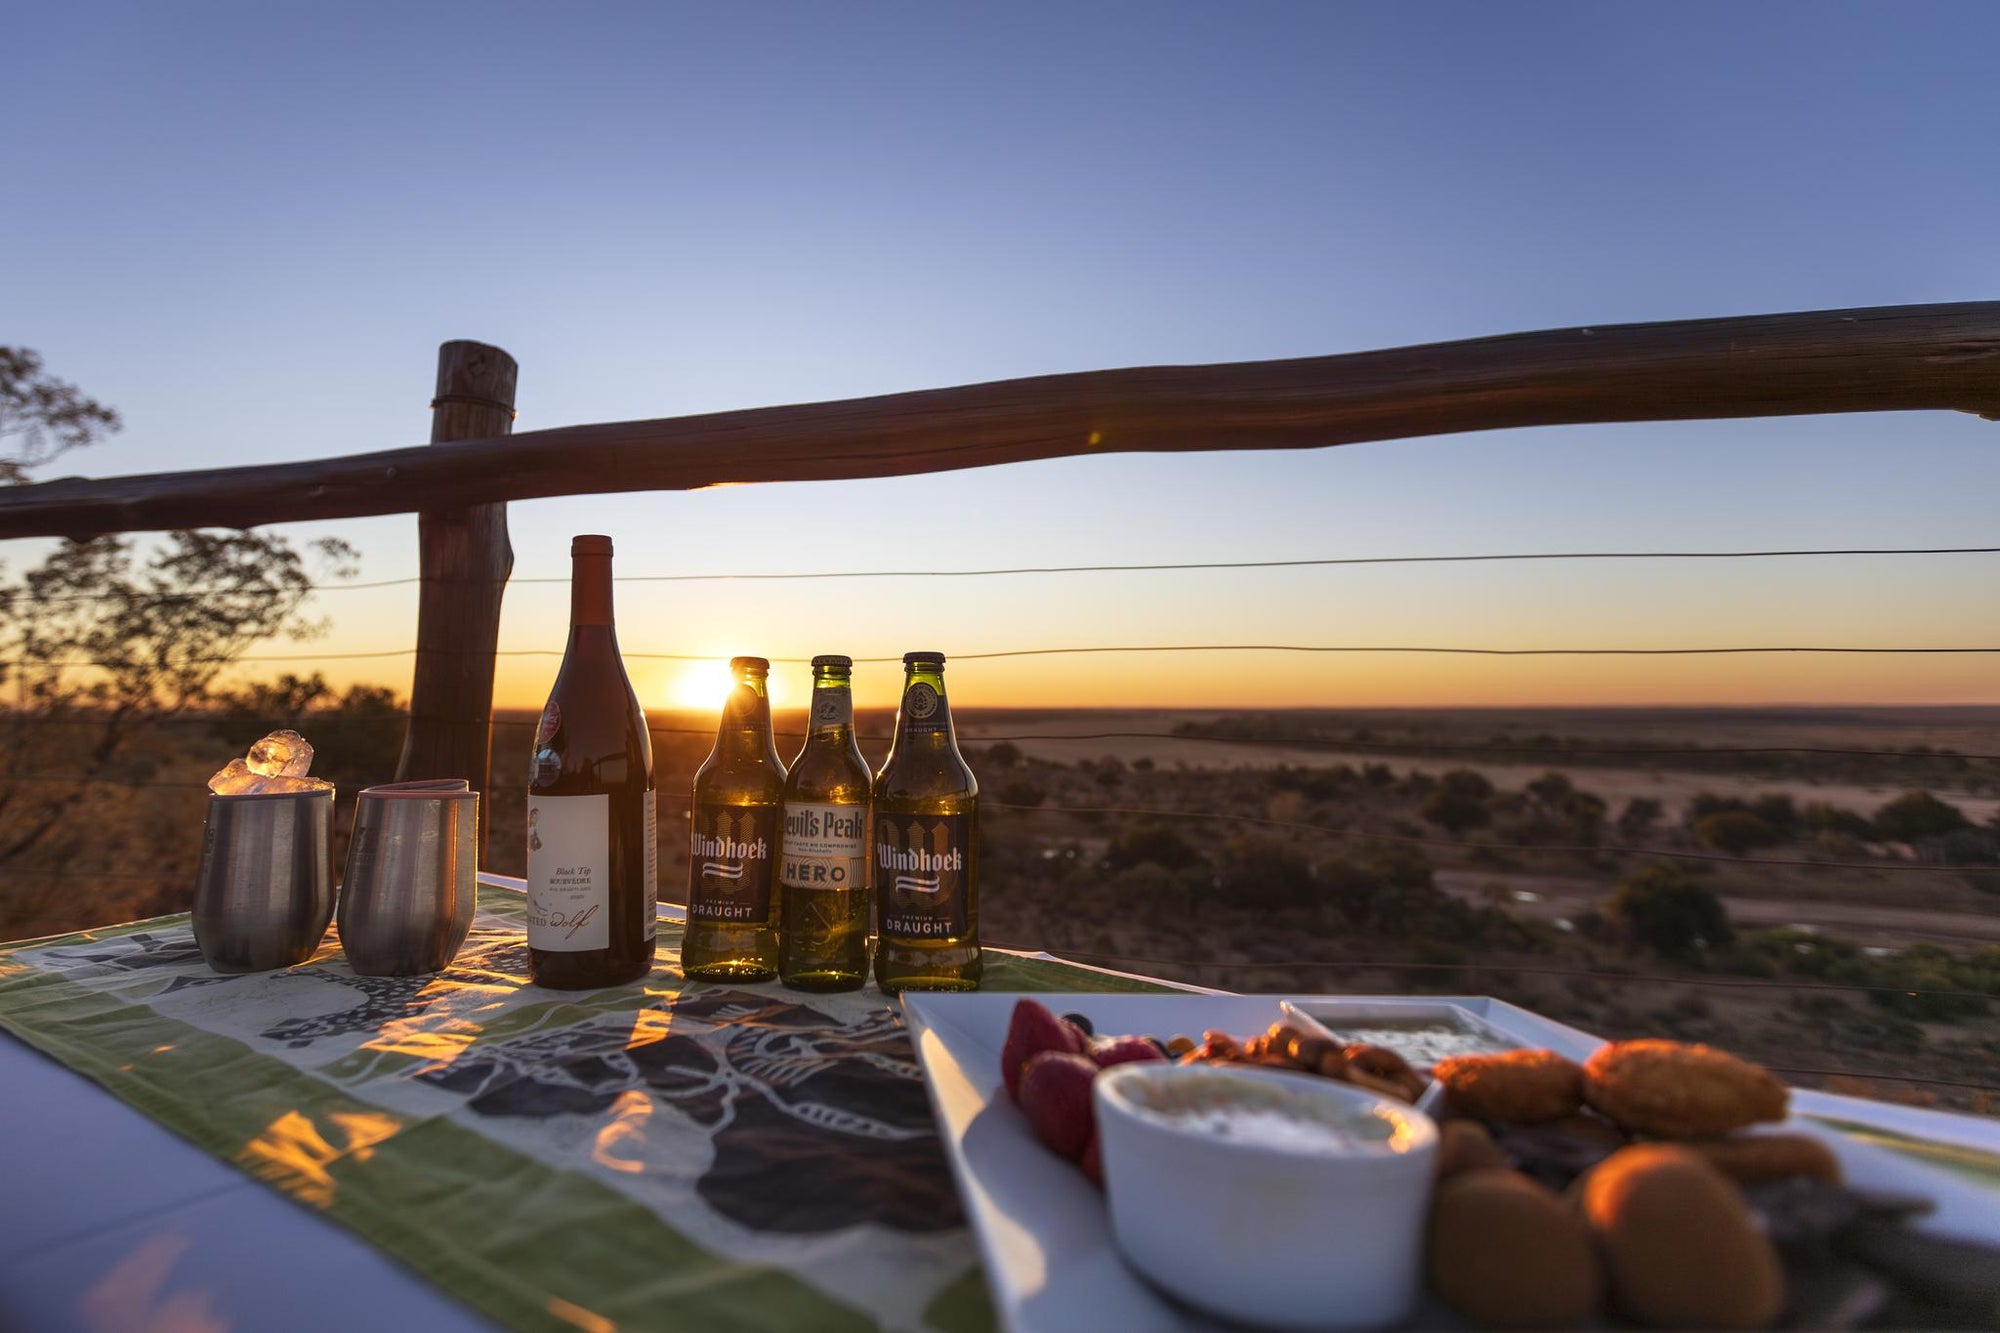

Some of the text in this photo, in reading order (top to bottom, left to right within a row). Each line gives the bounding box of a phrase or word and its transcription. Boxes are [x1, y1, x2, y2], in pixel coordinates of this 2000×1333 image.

[784, 810, 863, 839] evil's Peak
[691, 832, 767, 860] Windhoek
[877, 842, 962, 872] Windhoek
[555, 866, 591, 877] Black Tip
[786, 862, 846, 882] HERO
[692, 904, 752, 918] DRAUGHT
[886, 918, 952, 934] DRAUGHT
